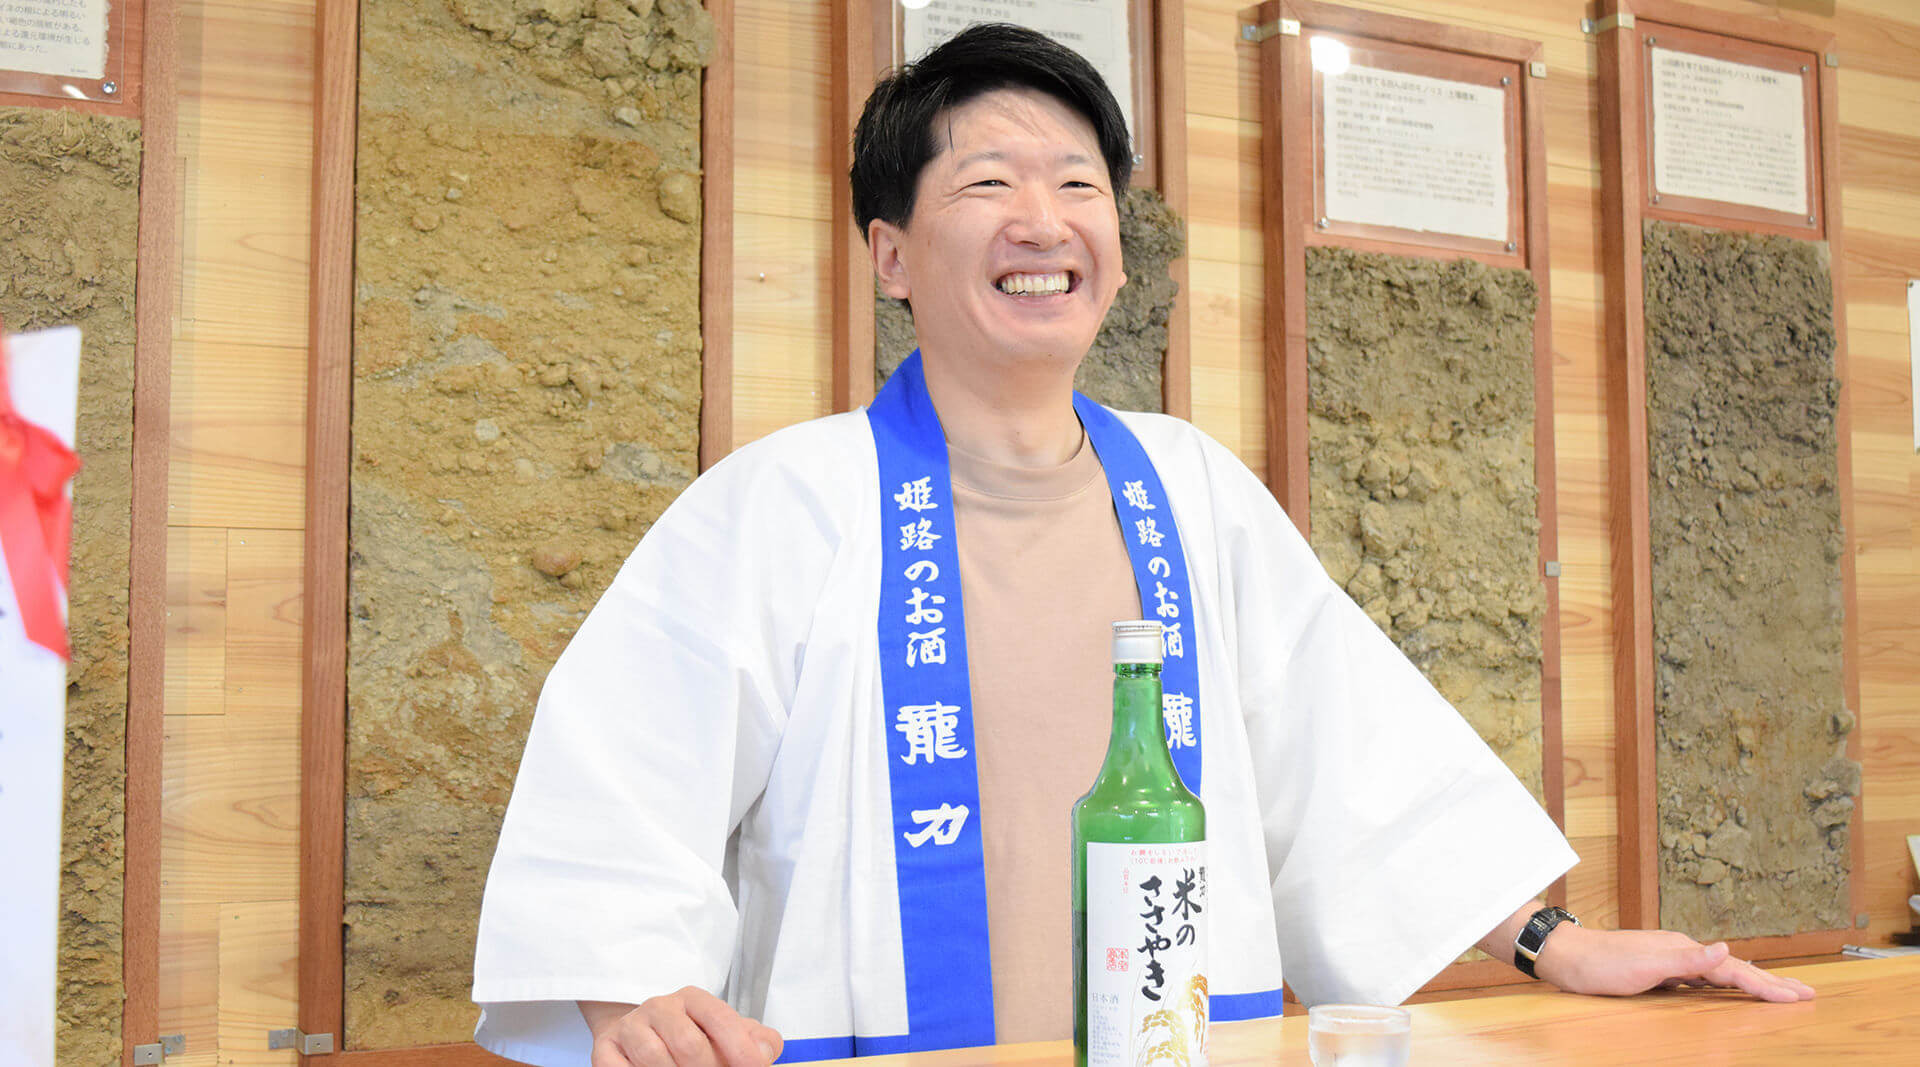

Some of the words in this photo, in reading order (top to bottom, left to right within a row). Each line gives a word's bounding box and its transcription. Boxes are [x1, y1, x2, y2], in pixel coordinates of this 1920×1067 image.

[893, 476, 947, 668] 姫路のお酒
[1137, 875, 1171, 1001] ささやき
[1172, 867, 1203, 946] 米の
